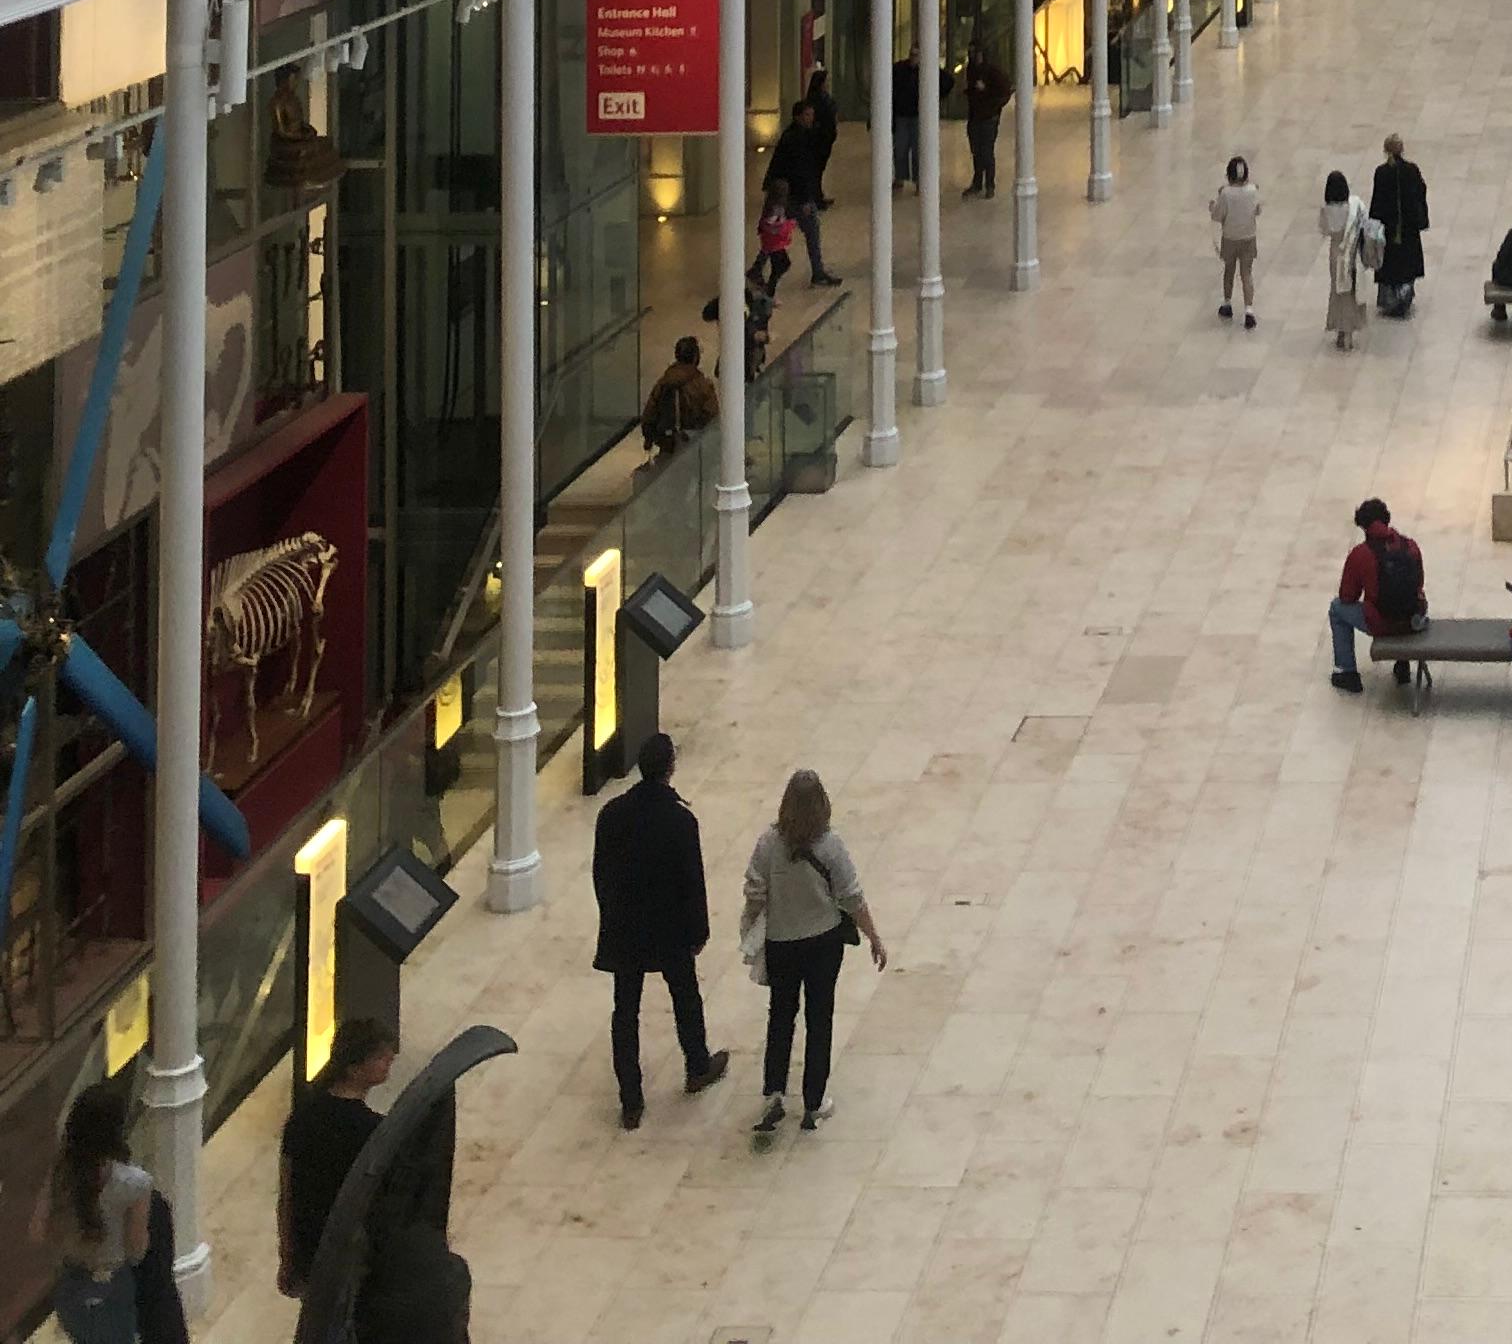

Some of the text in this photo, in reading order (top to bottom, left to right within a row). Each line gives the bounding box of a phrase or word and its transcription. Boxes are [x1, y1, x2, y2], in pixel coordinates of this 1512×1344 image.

[597, 5, 677, 19] Entrance Hall
[597, 26, 685, 37] Museum Kitchen
[598, 45, 624, 57] Shop
[599, 64, 632, 75] Toilets
[603, 97, 640, 114] Exit
